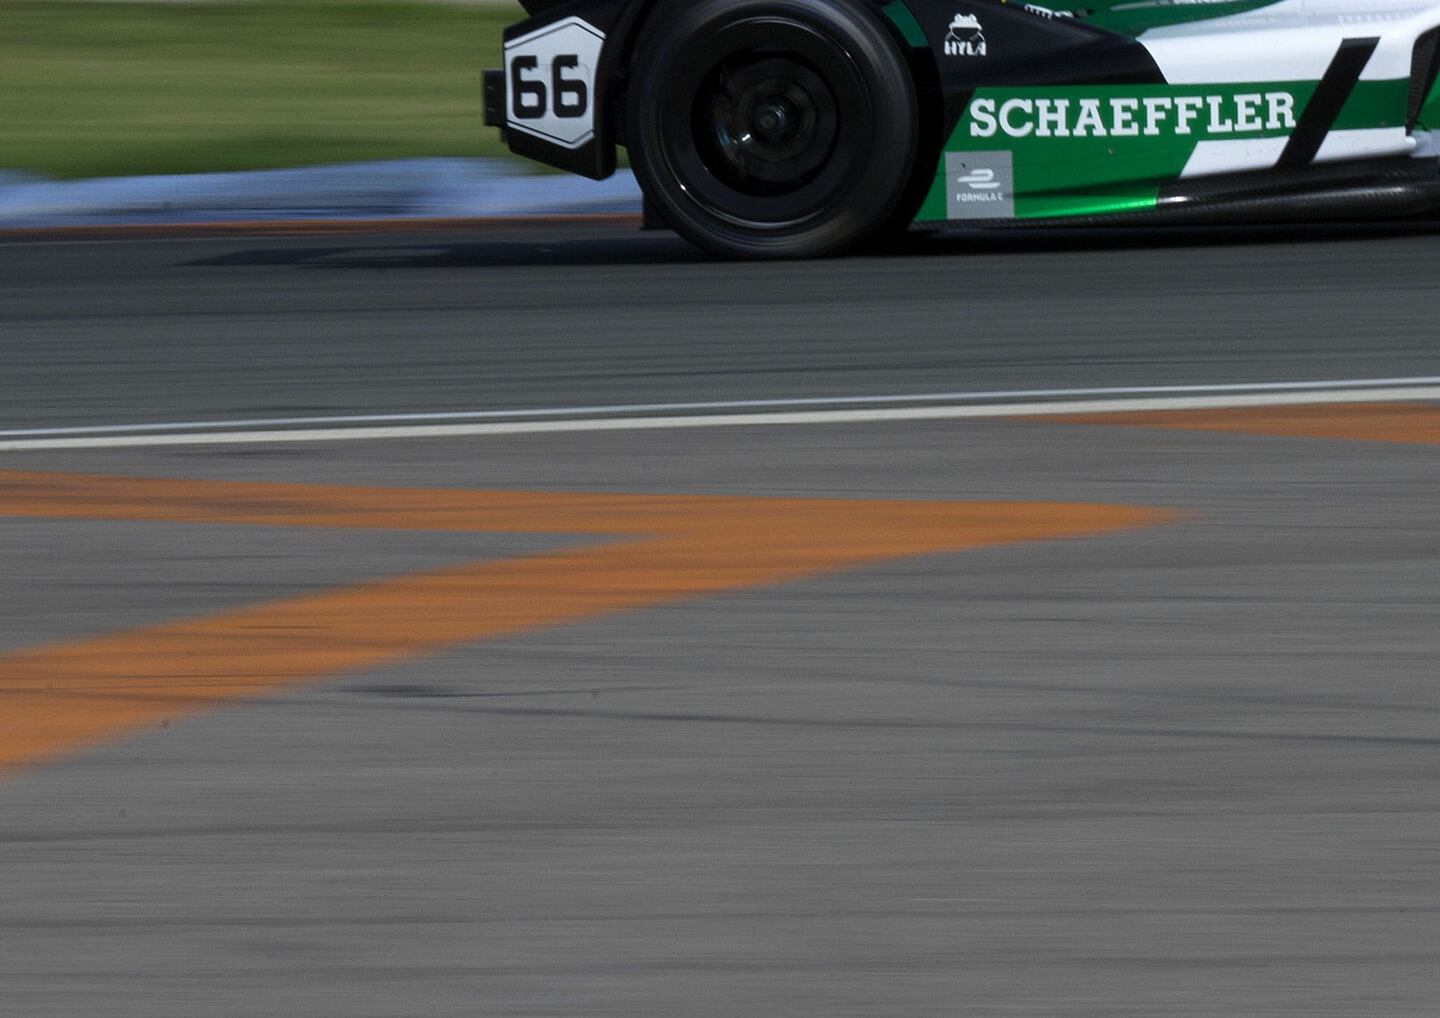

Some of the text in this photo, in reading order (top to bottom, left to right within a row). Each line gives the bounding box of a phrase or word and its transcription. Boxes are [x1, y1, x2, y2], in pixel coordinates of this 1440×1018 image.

[944, 41, 987, 56] HYLA
[511, 54, 588, 119] 66
[970, 92, 1296, 137] SCHAEFFLER
